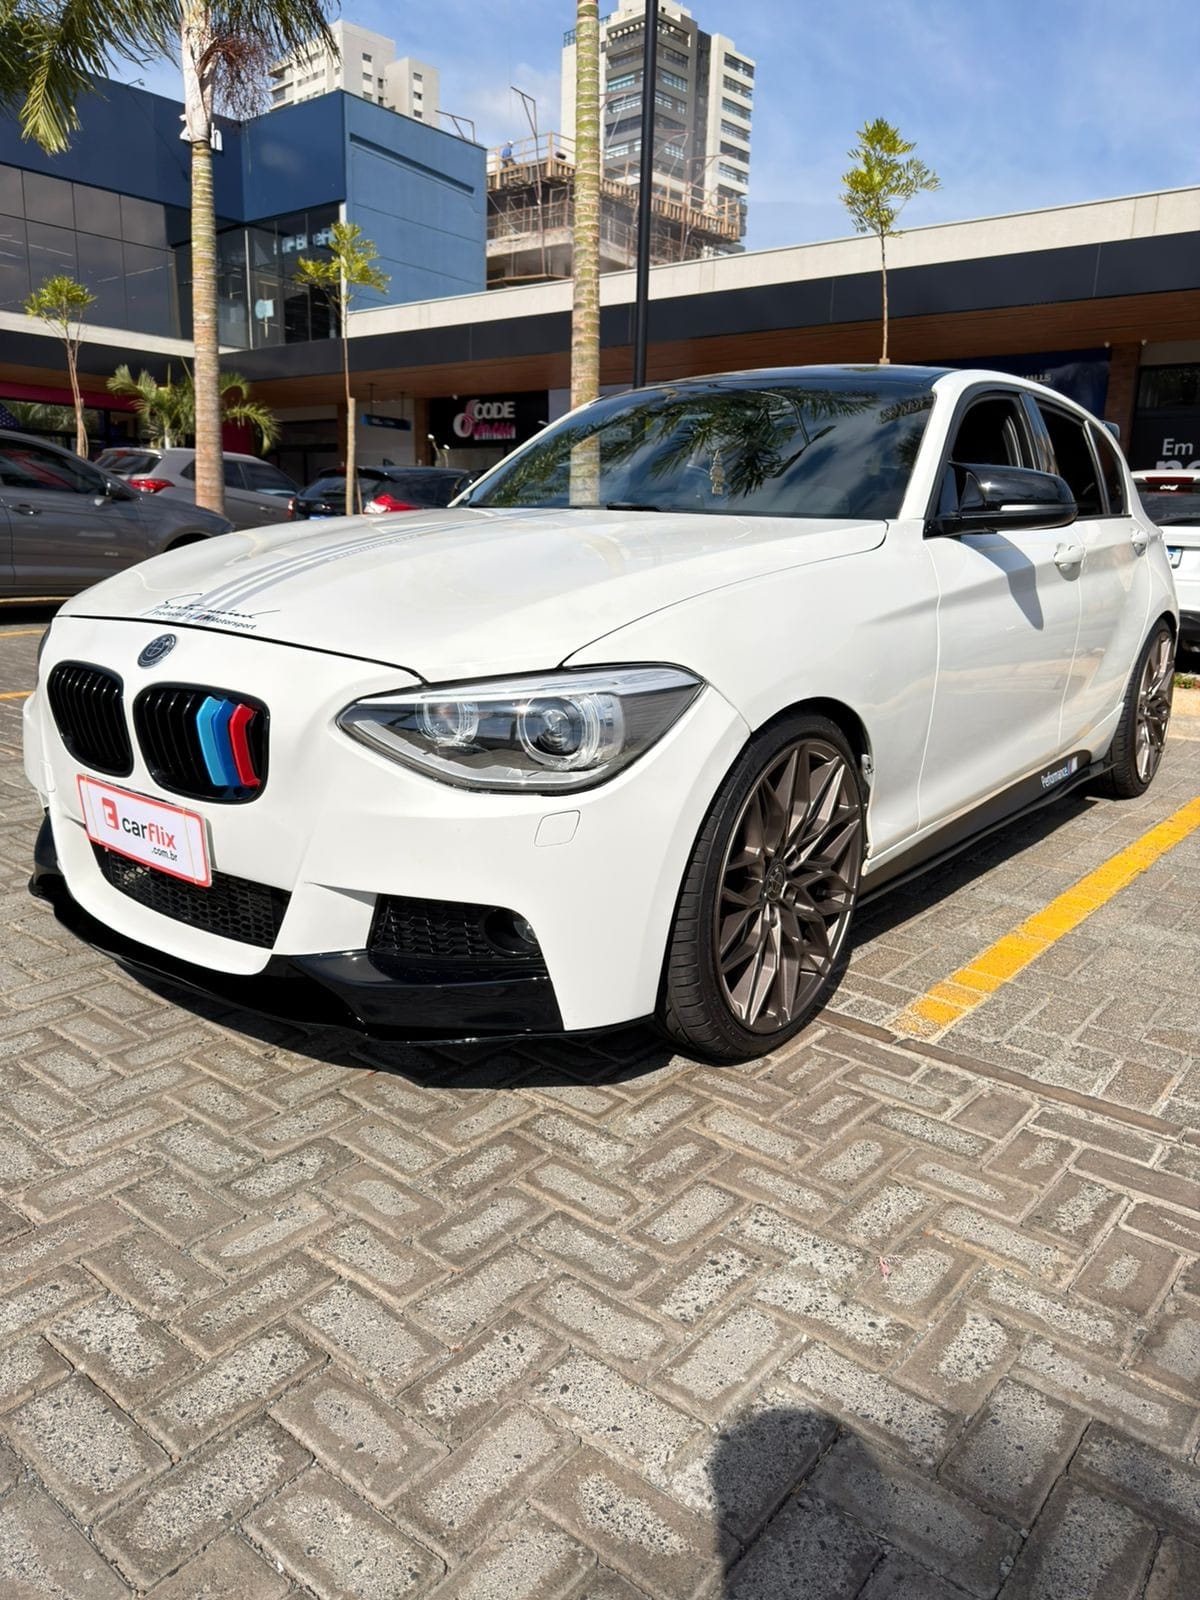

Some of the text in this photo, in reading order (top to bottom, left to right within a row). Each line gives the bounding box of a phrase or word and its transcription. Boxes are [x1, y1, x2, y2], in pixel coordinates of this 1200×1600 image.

[473, 401, 516, 419] CODE
[1162, 438, 1193, 456] Em
[1041, 767, 1068, 788] Performance
